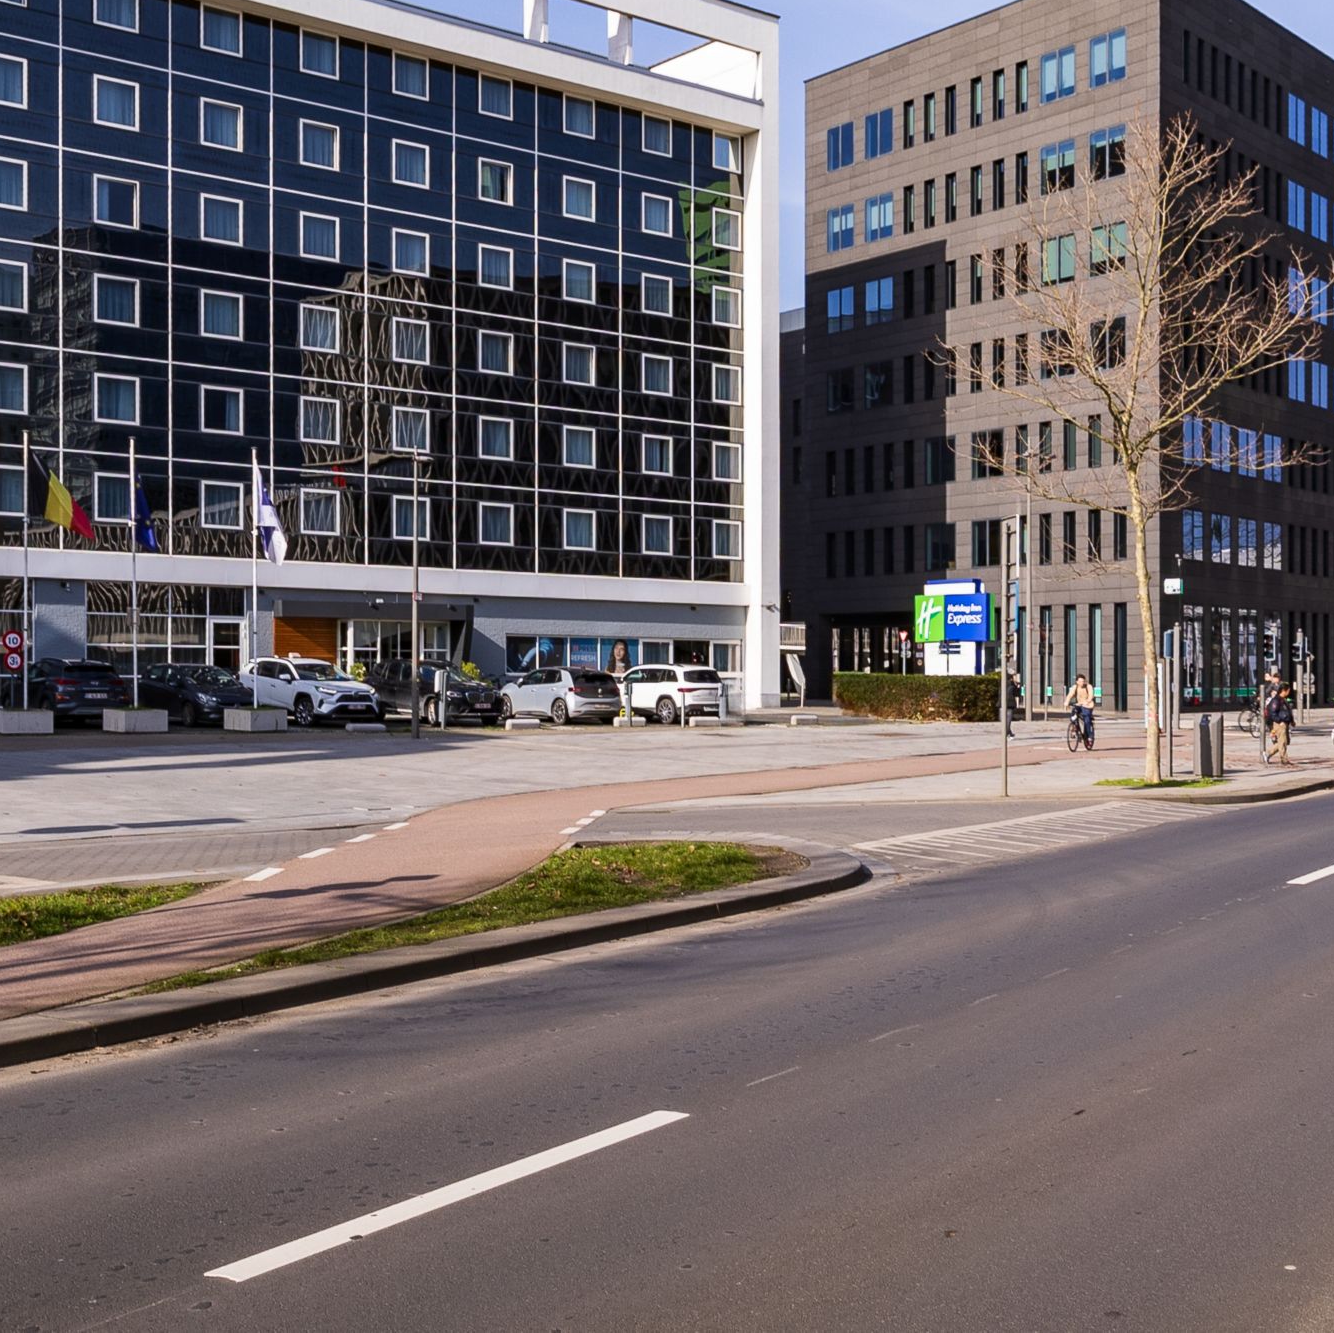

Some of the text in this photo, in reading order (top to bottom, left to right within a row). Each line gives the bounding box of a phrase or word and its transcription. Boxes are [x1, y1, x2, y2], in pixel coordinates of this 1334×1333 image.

[947, 603, 982, 614] Holiday Inn
[947, 613, 982, 626] Express
[8, 636, 18, 645] 10
